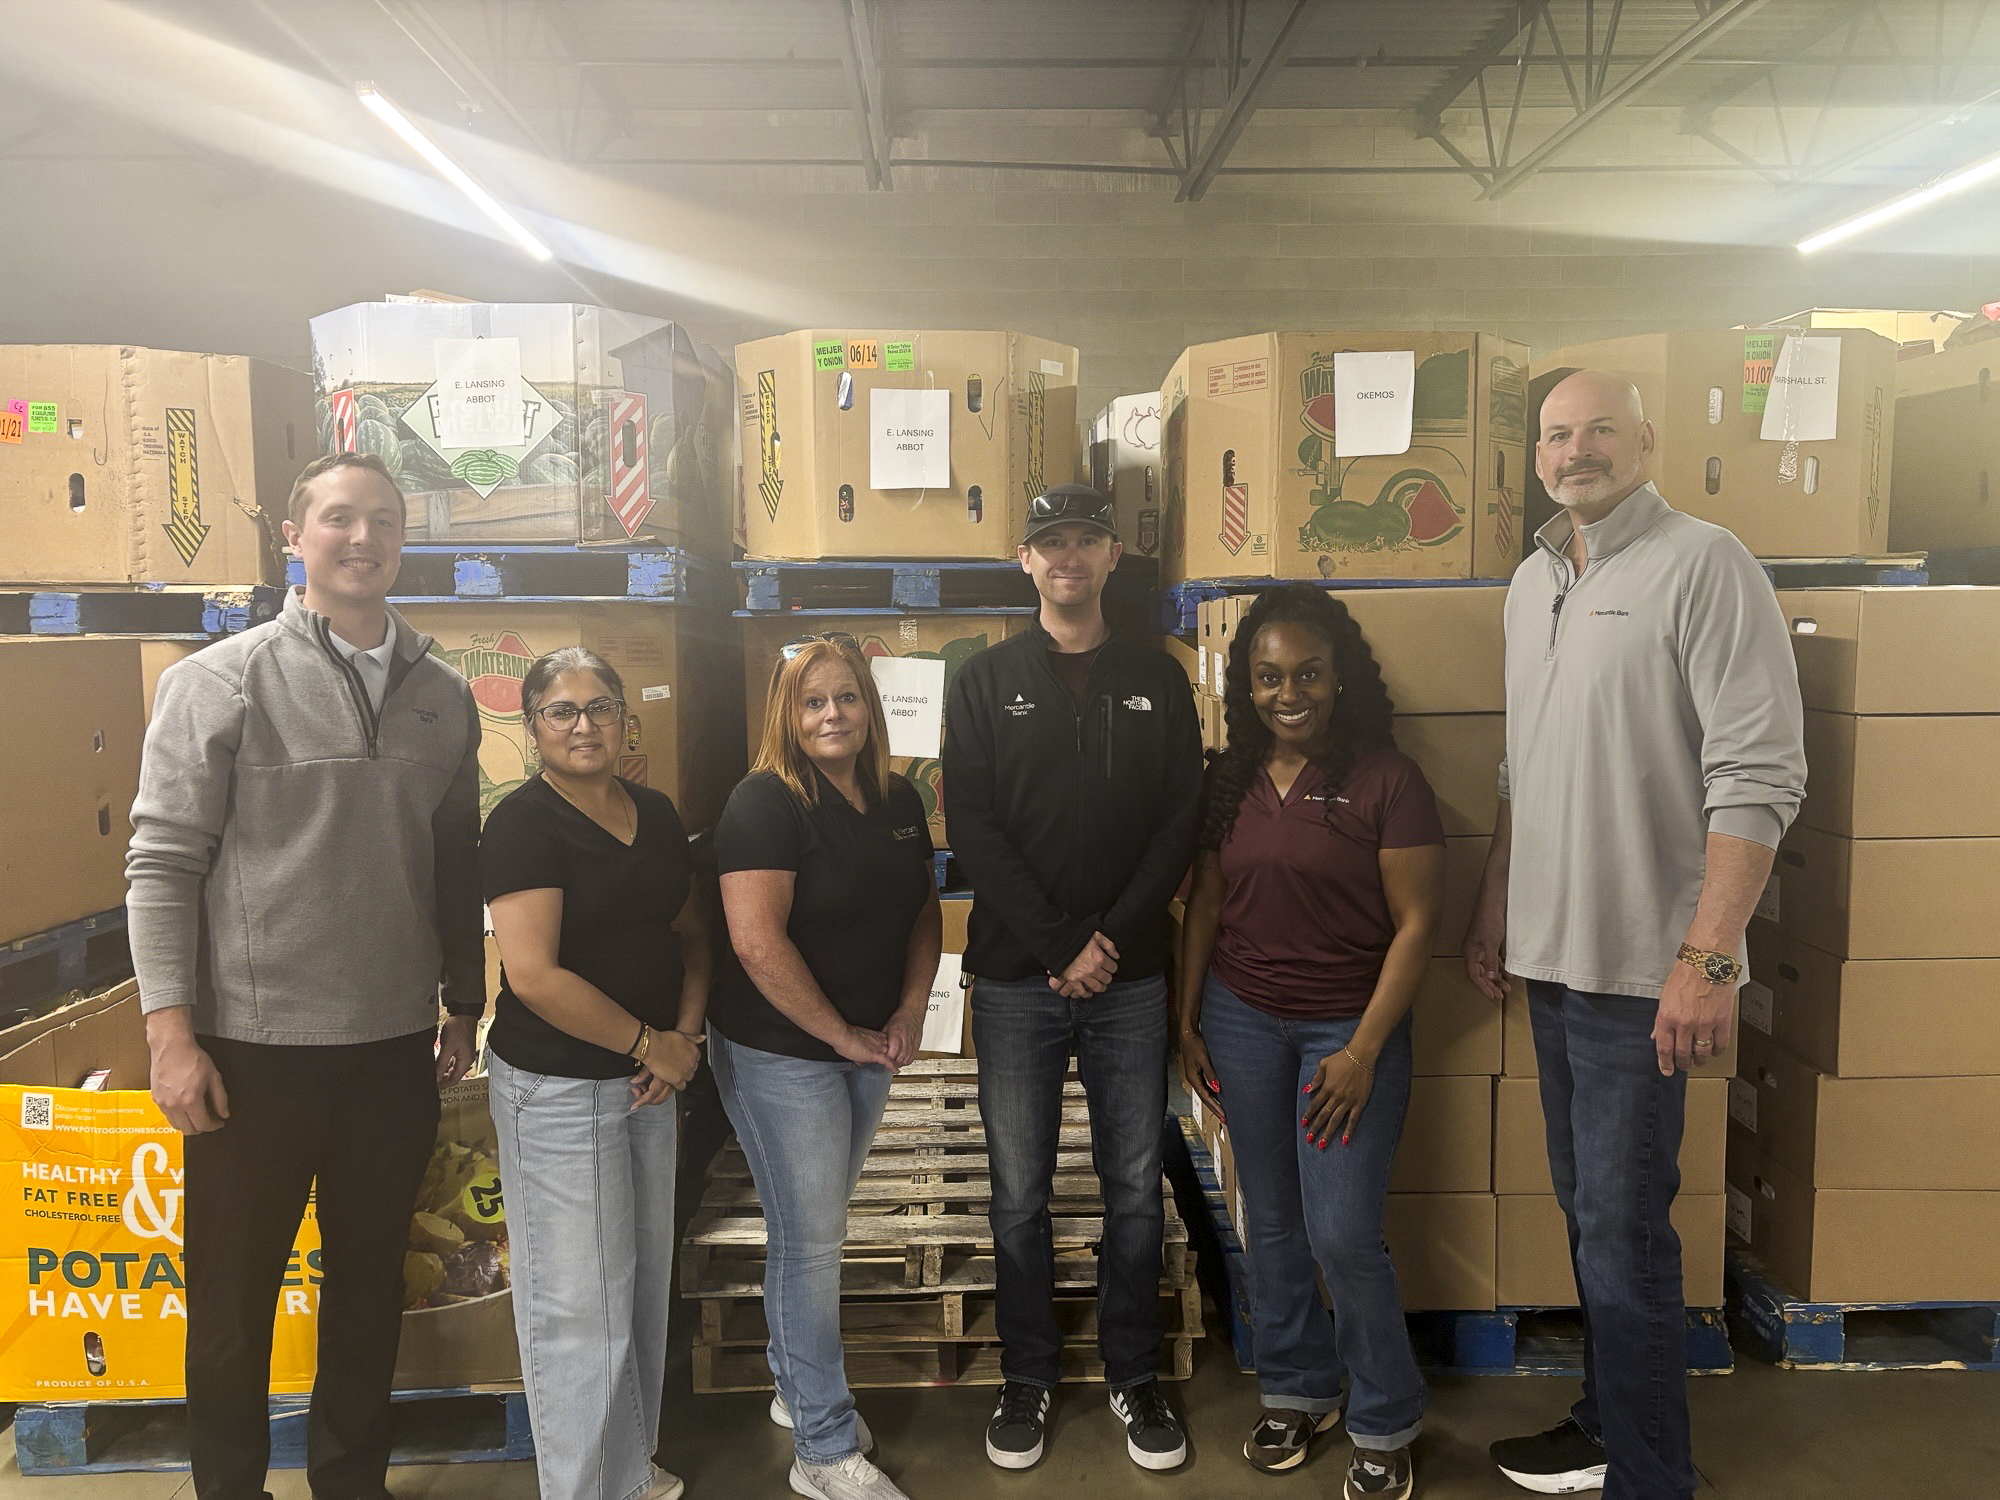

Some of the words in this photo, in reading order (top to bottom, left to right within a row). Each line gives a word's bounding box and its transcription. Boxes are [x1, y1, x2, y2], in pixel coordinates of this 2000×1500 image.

[1746, 340, 1772, 348] MEIJER
[816, 345, 843, 355] MEIJER
[850, 344, 877, 365] 06/14
[1746, 352, 1750, 360] R
[1752, 351, 1771, 359] ONION
[817, 358, 823, 367] Y
[823, 356, 843, 366] ONION
[1744, 367, 1772, 384] 01/07
[1774, 376, 1813, 385] MARSHALL
[1814, 376, 1827, 385] ST.
[465, 380, 505, 389] LANSING
[466, 395, 496, 404] ABBOT
[1357, 391, 1394, 400] OKEMOS
[0, 418, 22, 440] 1/21
[886, 428, 894, 437] E.
[896, 429, 934, 437] LANSING
[177, 432, 188, 464] WATCH
[896, 443, 925, 451] ABBOT
[181, 496, 189, 521] STEP
[470, 632, 495, 646] Fresh
[882, 694, 890, 702] E.
[891, 695, 928, 704] LANSING
[1004, 702, 1035, 711] Mercantile
[890, 708, 918, 717] ABBOT
[448, 1084, 481, 1094] POTATO
[461, 1093, 480, 1102] AND
[54, 1104, 80, 1113] Discover
[96, 1107, 145, 1115] mouthwatering
[54, 1123, 178, 1135] WWW.POTATOGOODNESS.COM
[22, 1162, 122, 1185] HEALTHY
[122, 1142, 184, 1247] &
[23, 1187, 59, 1203] FAT
[67, 1191, 119, 1207] FREE
[24, 1208, 94, 1222] CHOLESTEROL
[95, 1214, 121, 1223] FREE
[28, 1289, 144, 1320] HAVE
[36, 1380, 92, 1388] PRODUCE
